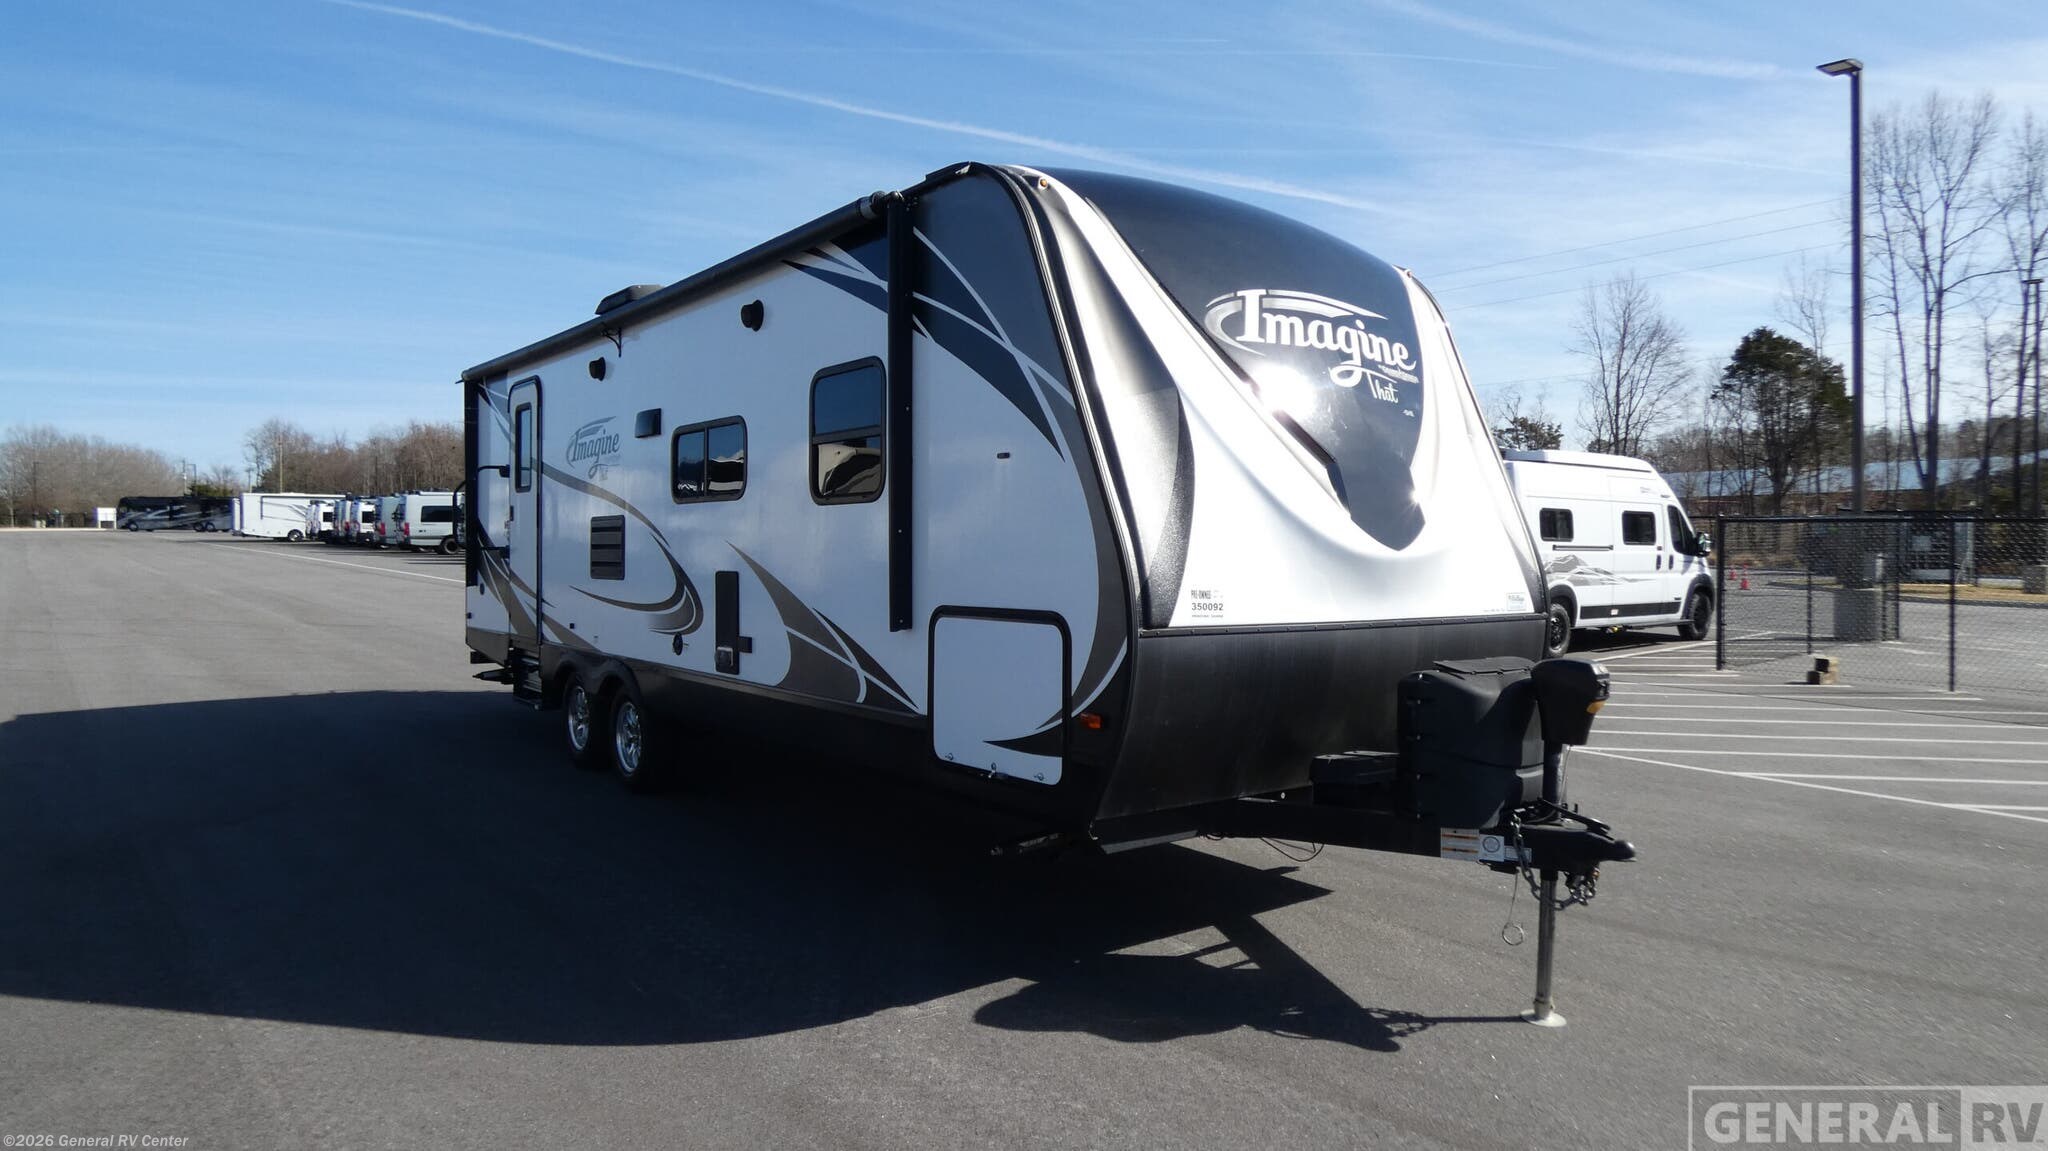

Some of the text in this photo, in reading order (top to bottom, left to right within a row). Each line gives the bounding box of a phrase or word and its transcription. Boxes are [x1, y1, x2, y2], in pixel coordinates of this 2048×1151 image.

[1236, 289, 1416, 387] Imagine
[1366, 370, 1399, 403] That
[571, 428, 620, 479] Imagine
[1191, 603, 1224, 611] 350092
